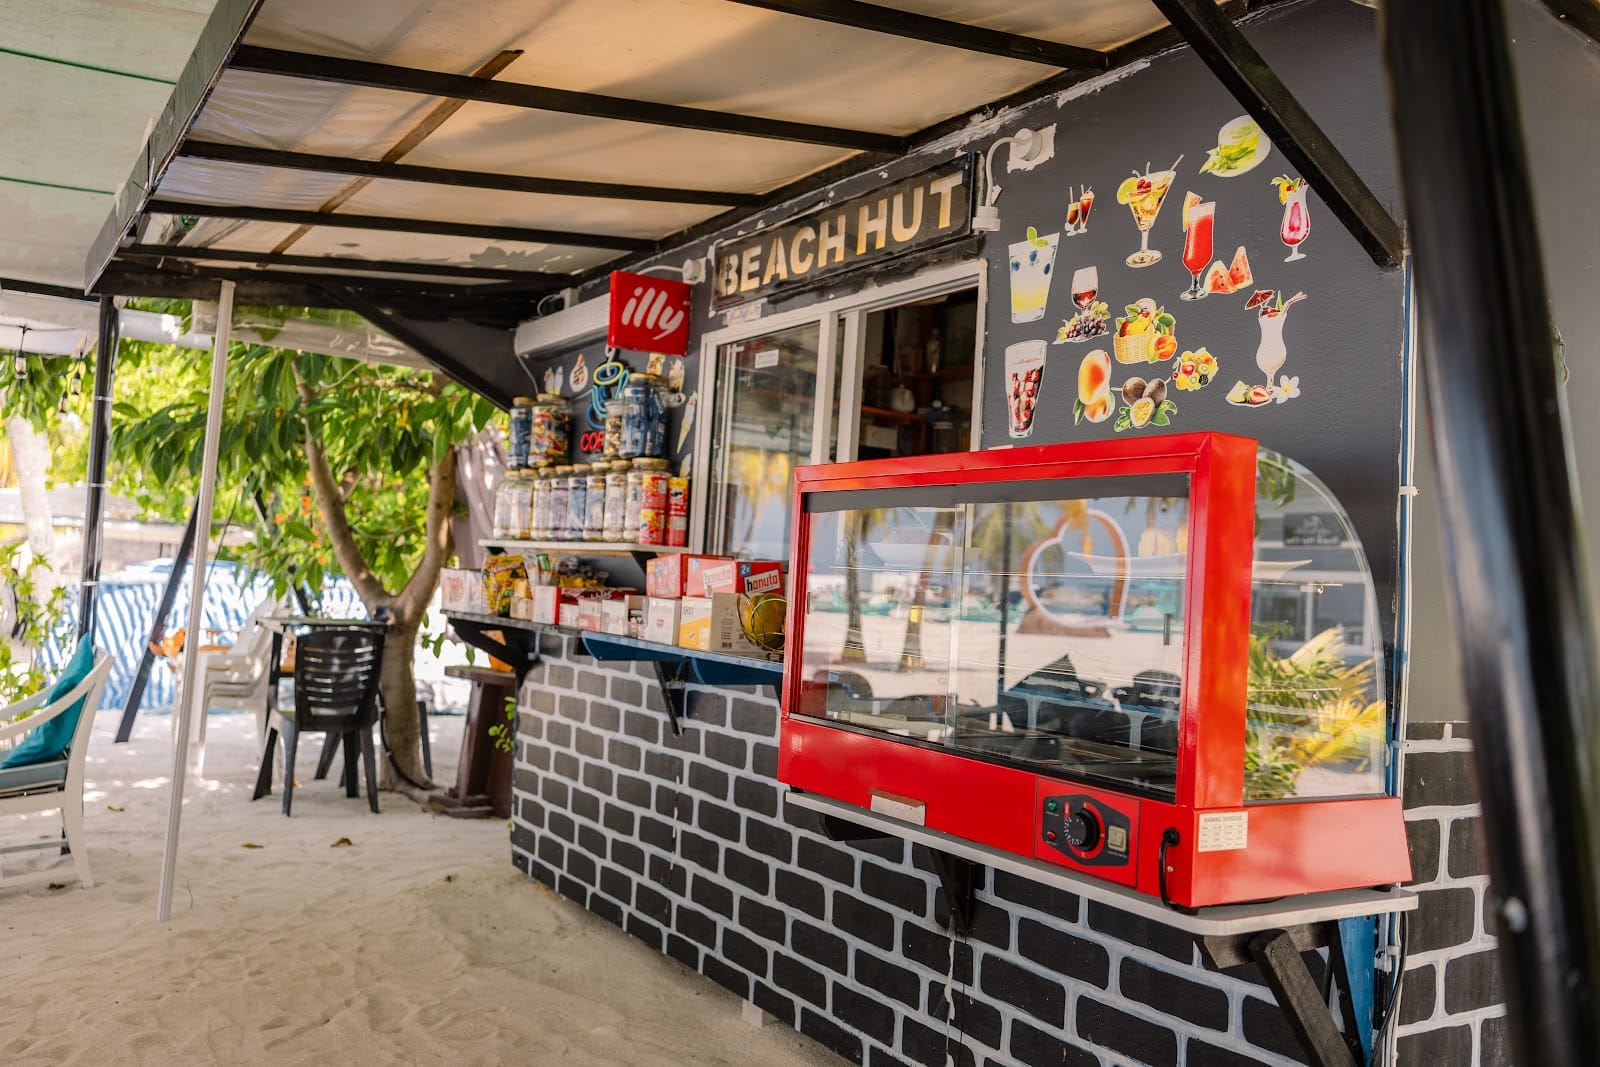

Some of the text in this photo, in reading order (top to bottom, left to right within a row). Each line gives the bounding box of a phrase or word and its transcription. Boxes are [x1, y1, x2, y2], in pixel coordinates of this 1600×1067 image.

[719, 171, 963, 296] BEACH HUT
[621, 286, 685, 341] illy
[580, 431, 605, 452] COF
[746, 573, 778, 592] hanuta
